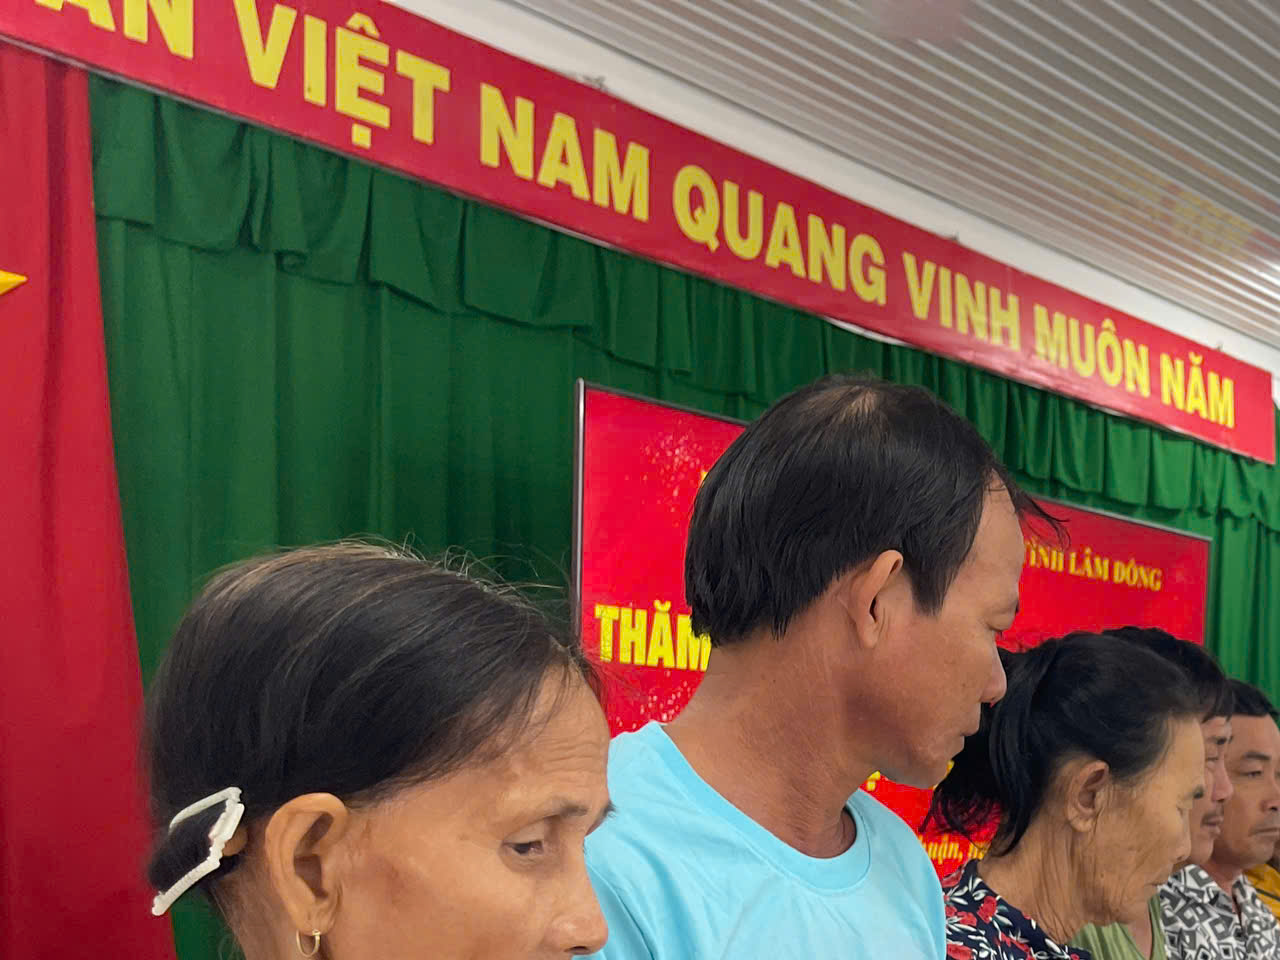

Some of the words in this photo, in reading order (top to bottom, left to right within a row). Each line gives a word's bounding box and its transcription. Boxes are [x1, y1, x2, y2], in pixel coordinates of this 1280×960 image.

[234, 0, 450, 148] VIỆT
[480, 84, 649, 221] NAM
[673, 166, 886, 305] QUANG
[903, 253, 1020, 352] VINH
[1034, 304, 1150, 398] MUÔN
[1160, 352, 1235, 428] NĂM
[1069, 547, 1109, 581] LÂM
[595, 600, 711, 672] THĂM
